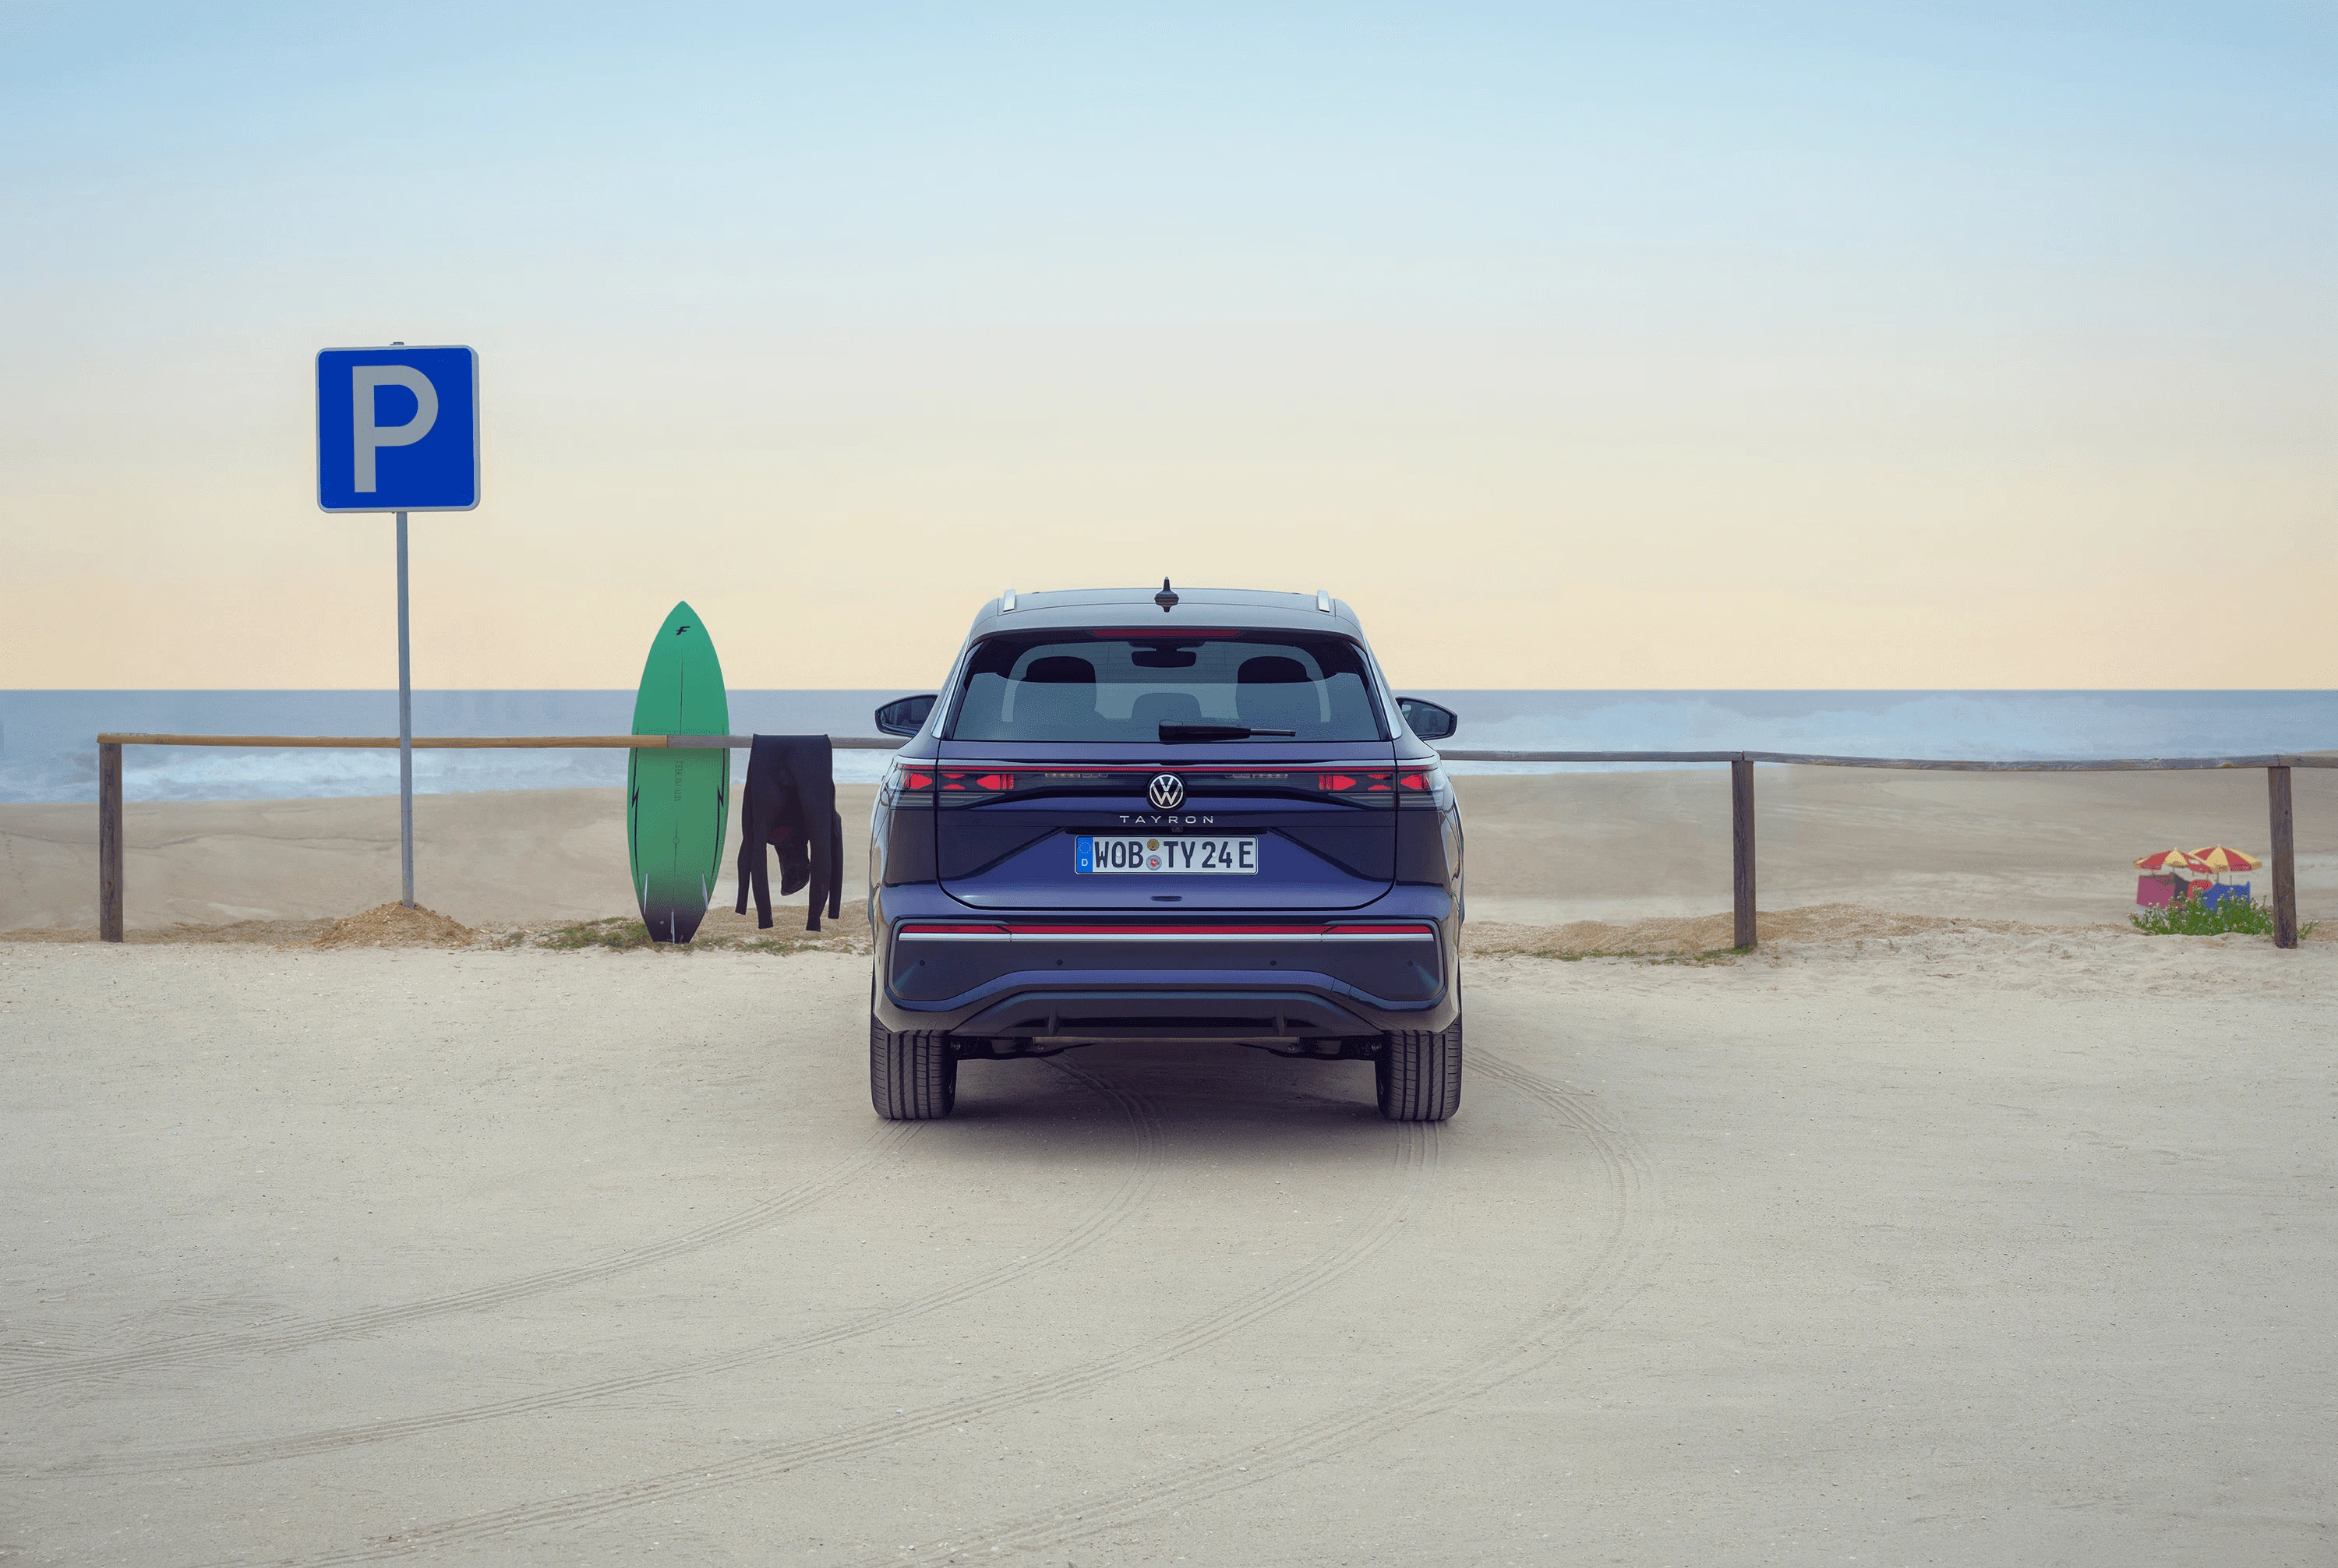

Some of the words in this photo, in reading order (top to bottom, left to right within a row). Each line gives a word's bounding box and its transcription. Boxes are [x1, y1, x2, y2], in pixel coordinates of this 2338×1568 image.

[352, 365, 439, 493] P
[1119, 815, 1213, 824] TAYRON
[1094, 841, 1143, 868] WOB
